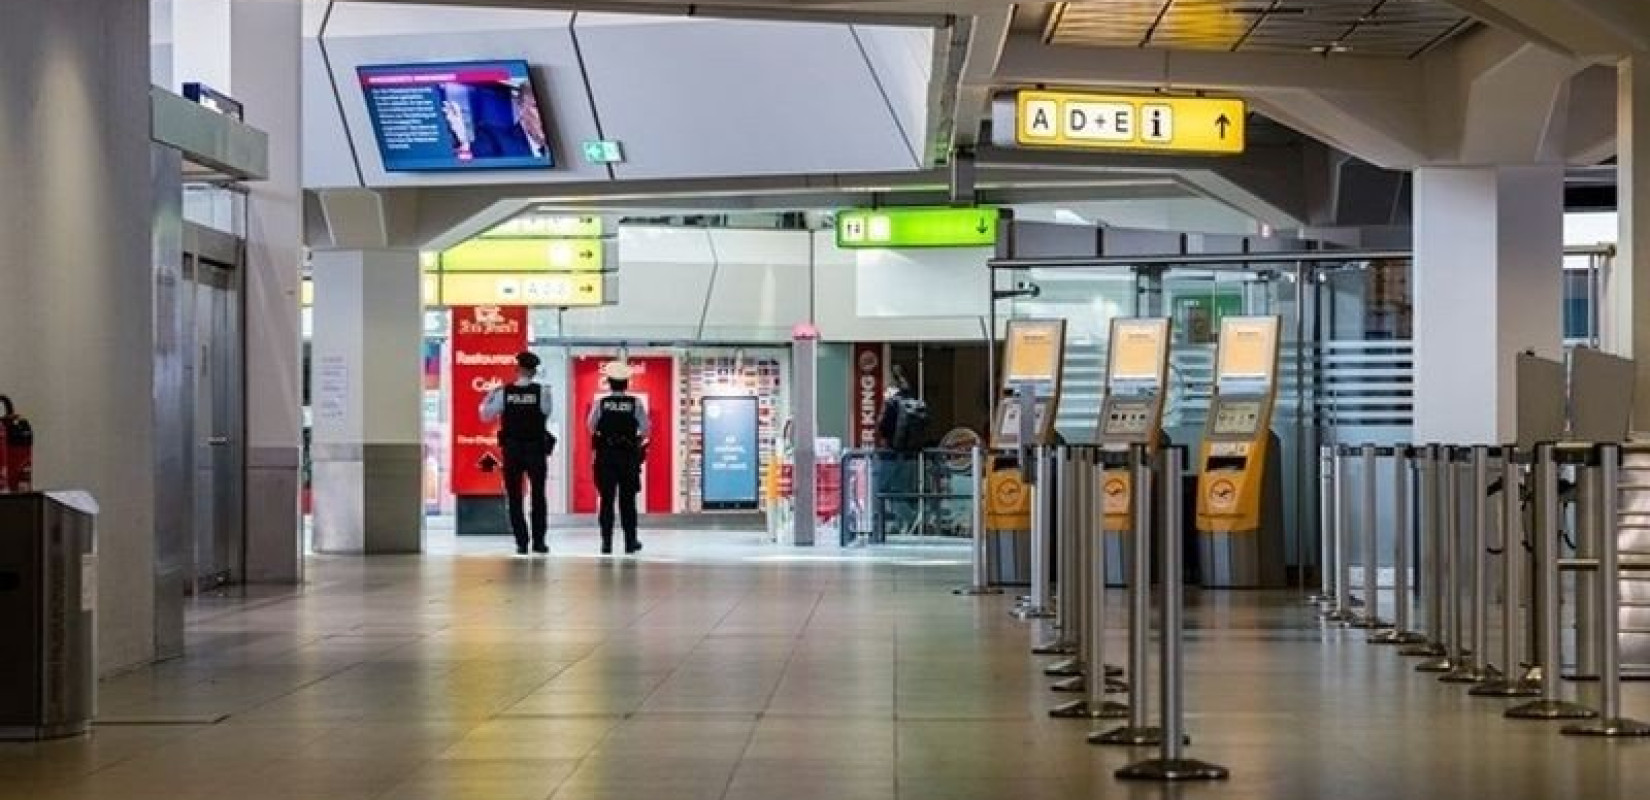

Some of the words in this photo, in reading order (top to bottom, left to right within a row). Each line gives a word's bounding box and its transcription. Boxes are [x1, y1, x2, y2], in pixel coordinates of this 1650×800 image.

[1032, 107, 1049, 130] A
[506, 393, 537, 404] POLIZEI
[603, 401, 634, 411] POLIZEI
[861, 374, 875, 425] KING
